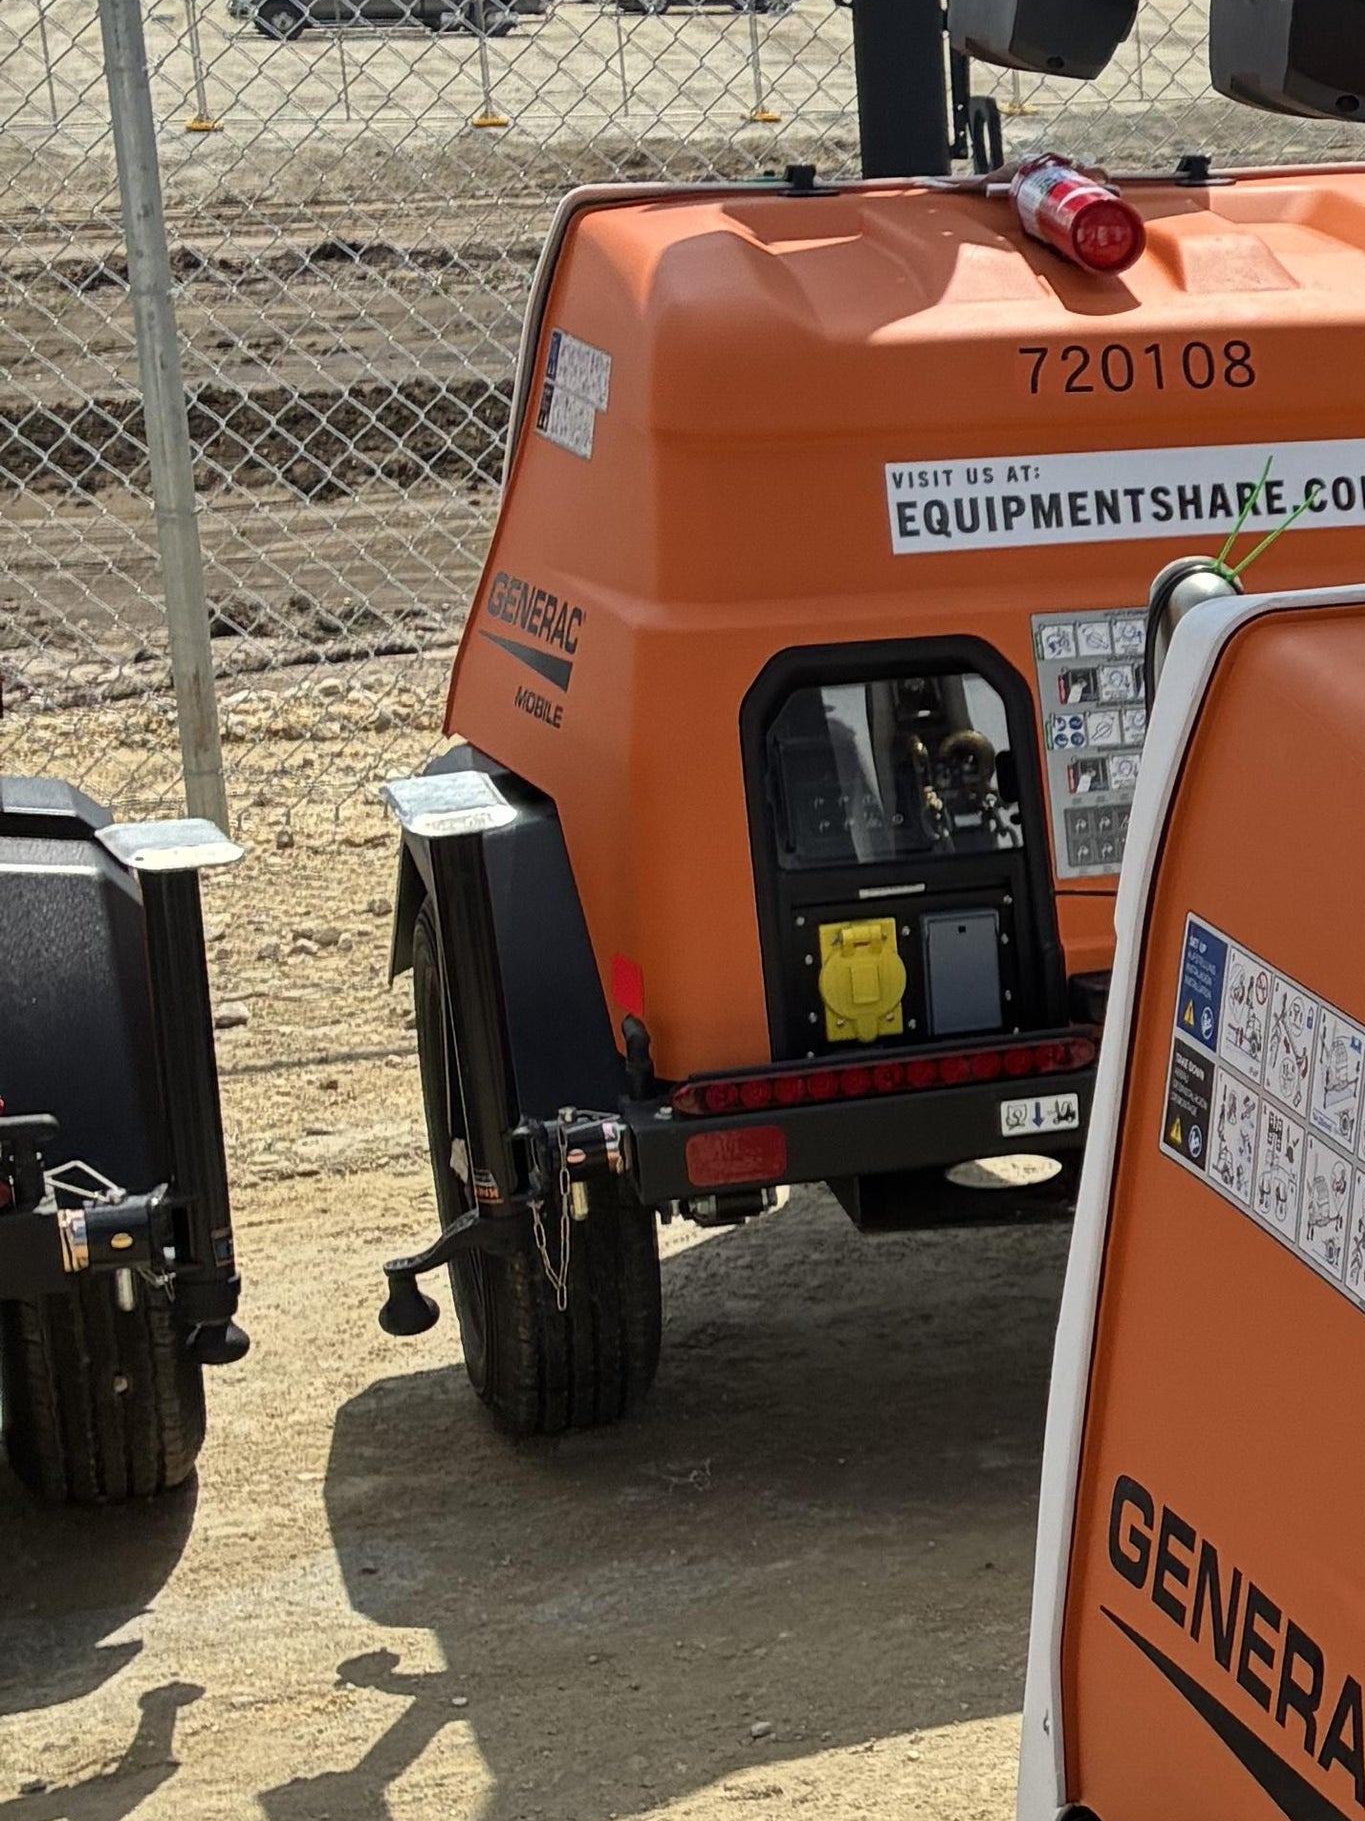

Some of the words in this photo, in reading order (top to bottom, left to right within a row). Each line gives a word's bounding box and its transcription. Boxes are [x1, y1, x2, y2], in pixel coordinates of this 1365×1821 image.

[1019, 341, 1256, 394] 720108
[892, 469, 953, 489] VISIT
[966, 467, 994, 485] US
[1007, 464, 1041, 482] AT:
[488, 572, 582, 655] GENERAC
[515, 686, 563, 729] MOBILE
